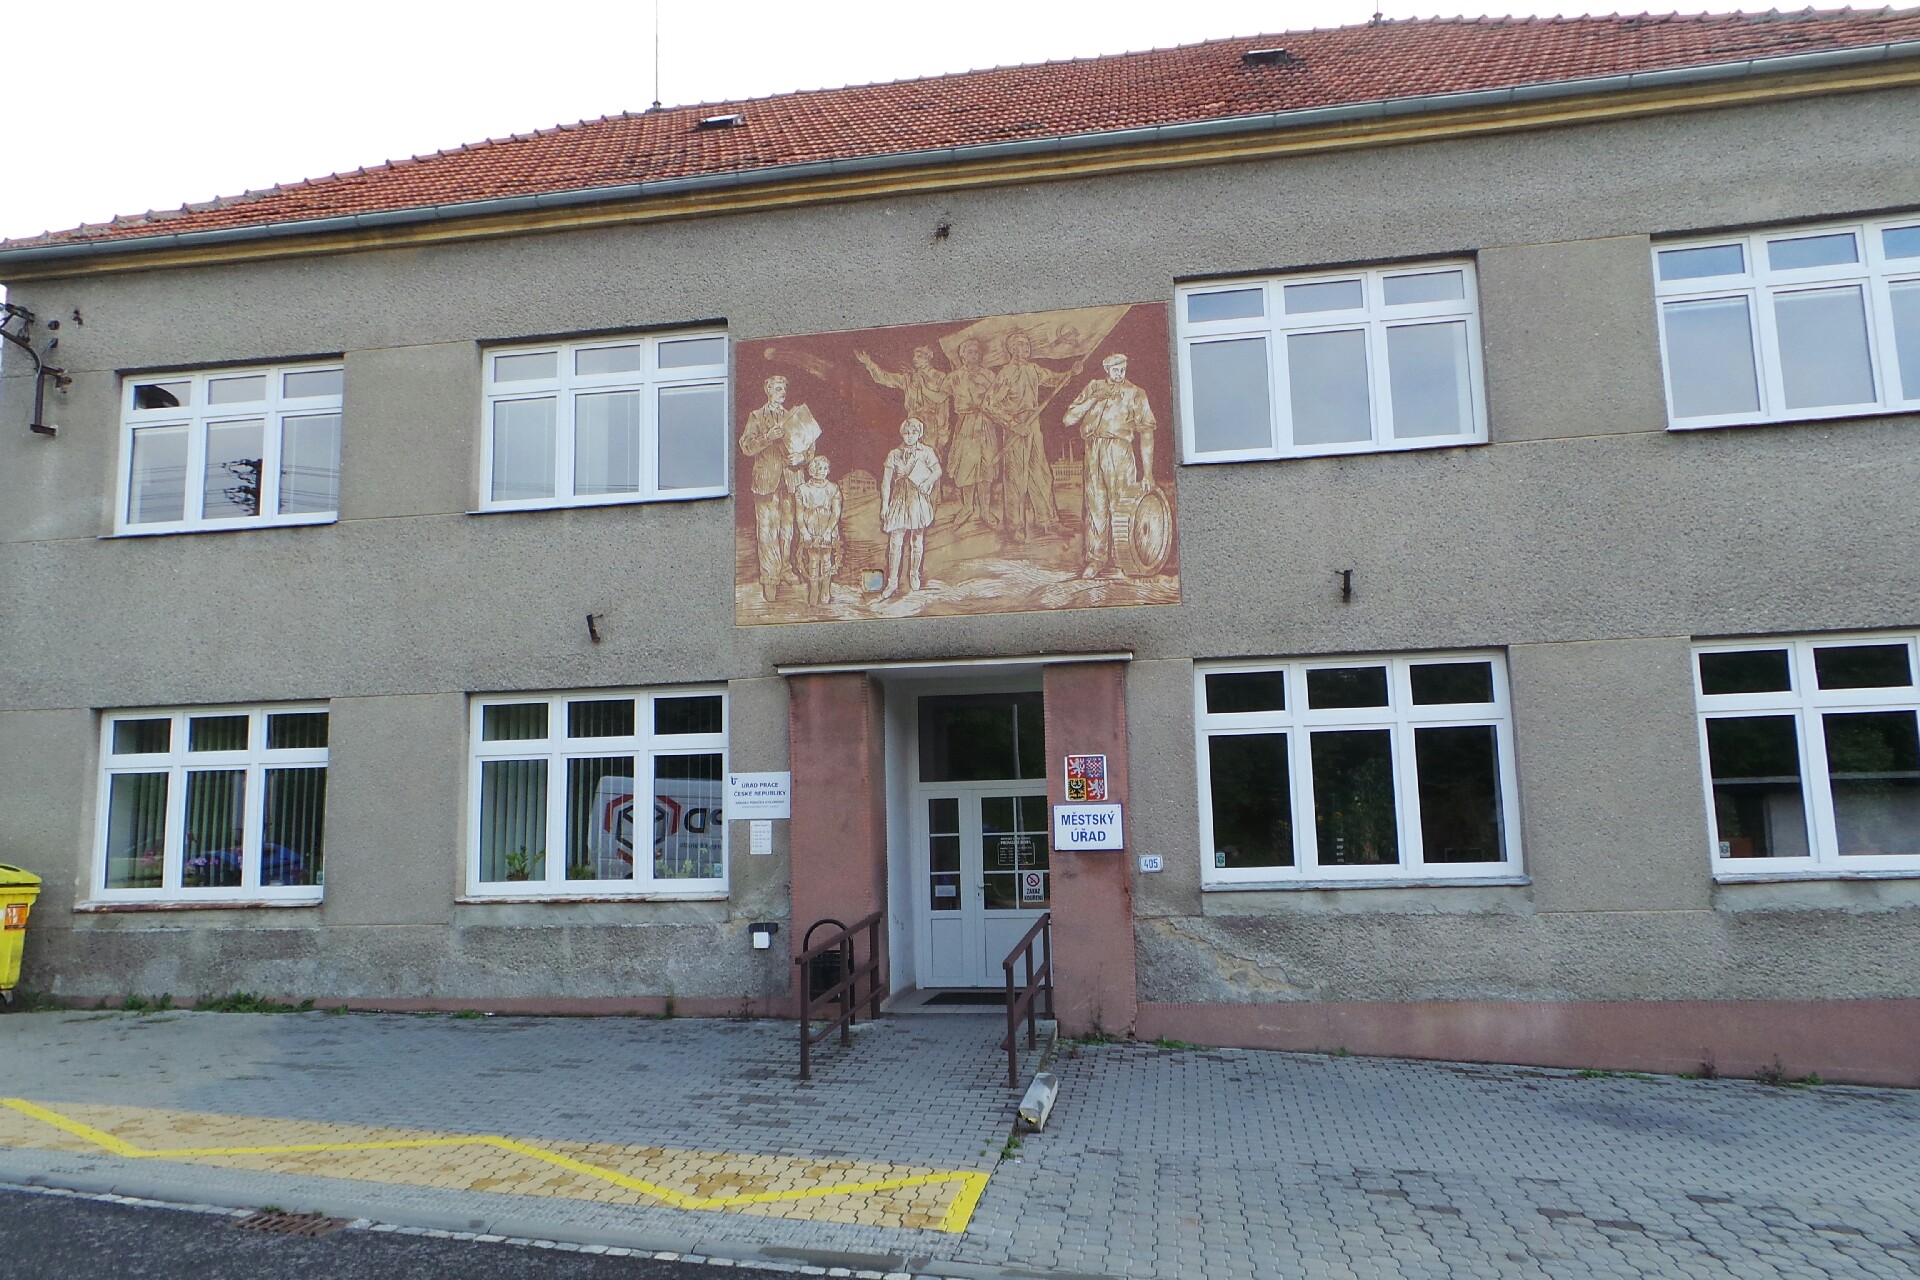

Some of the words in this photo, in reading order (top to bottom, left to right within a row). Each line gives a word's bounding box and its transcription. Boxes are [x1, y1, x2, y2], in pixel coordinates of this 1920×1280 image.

[1061, 811, 1115, 826] MĚSTSKÝ
[1071, 828, 1107, 842] ÚŘAD
[1144, 858, 1158, 869] 405
